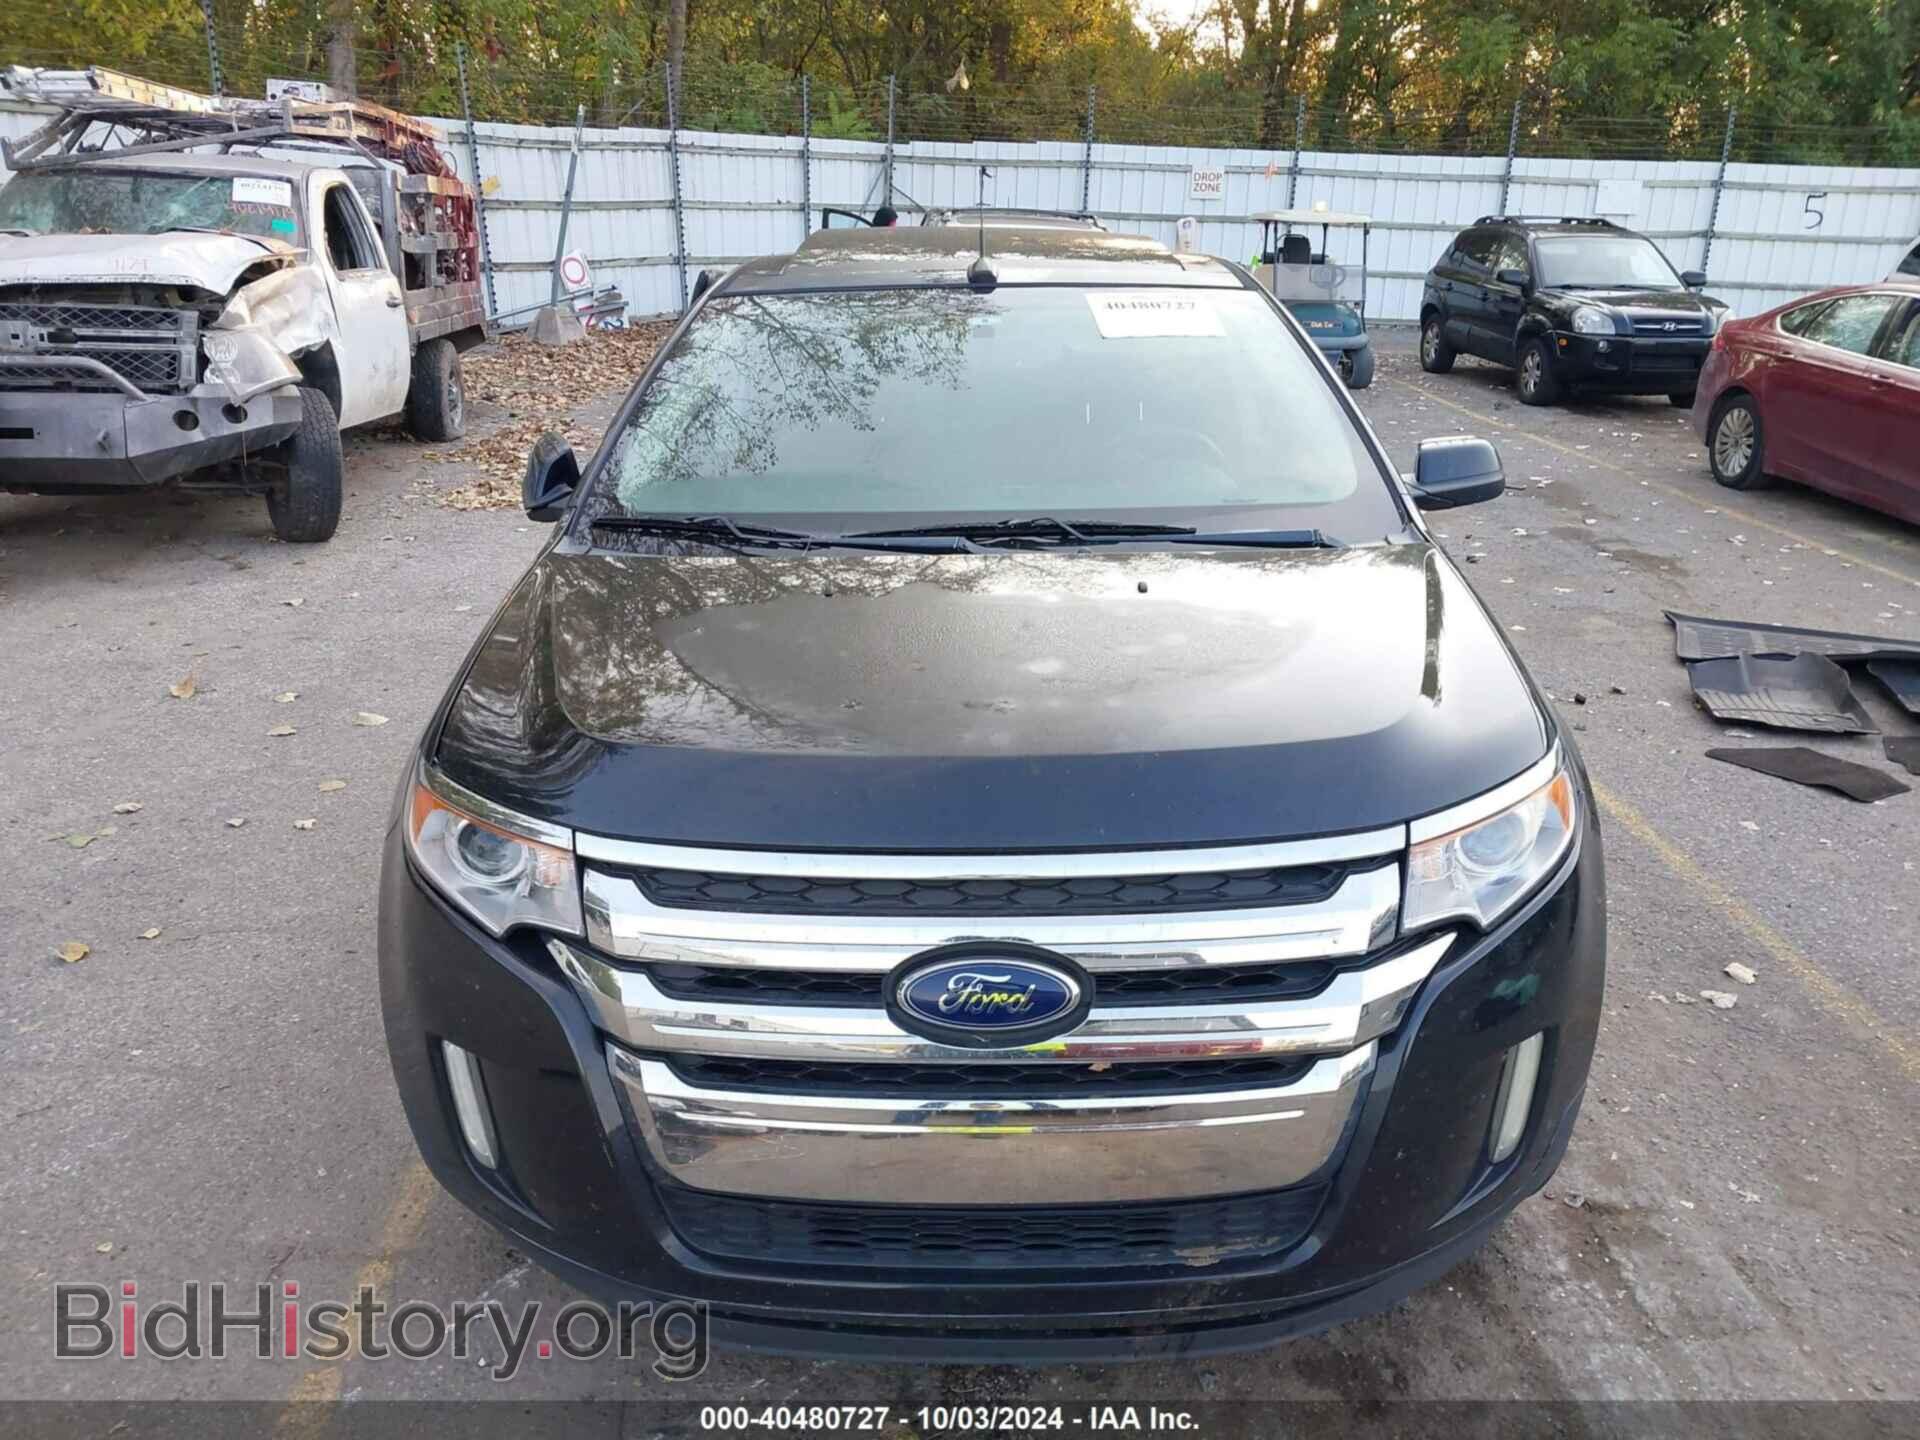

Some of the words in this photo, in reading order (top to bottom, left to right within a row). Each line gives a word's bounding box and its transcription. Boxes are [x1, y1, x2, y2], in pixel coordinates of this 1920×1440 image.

[1193, 172, 1223, 182] DROP
[1193, 183, 1222, 193] ZONE
[1804, 192, 1828, 230] 5
[938, 972, 1037, 1016] Ford
